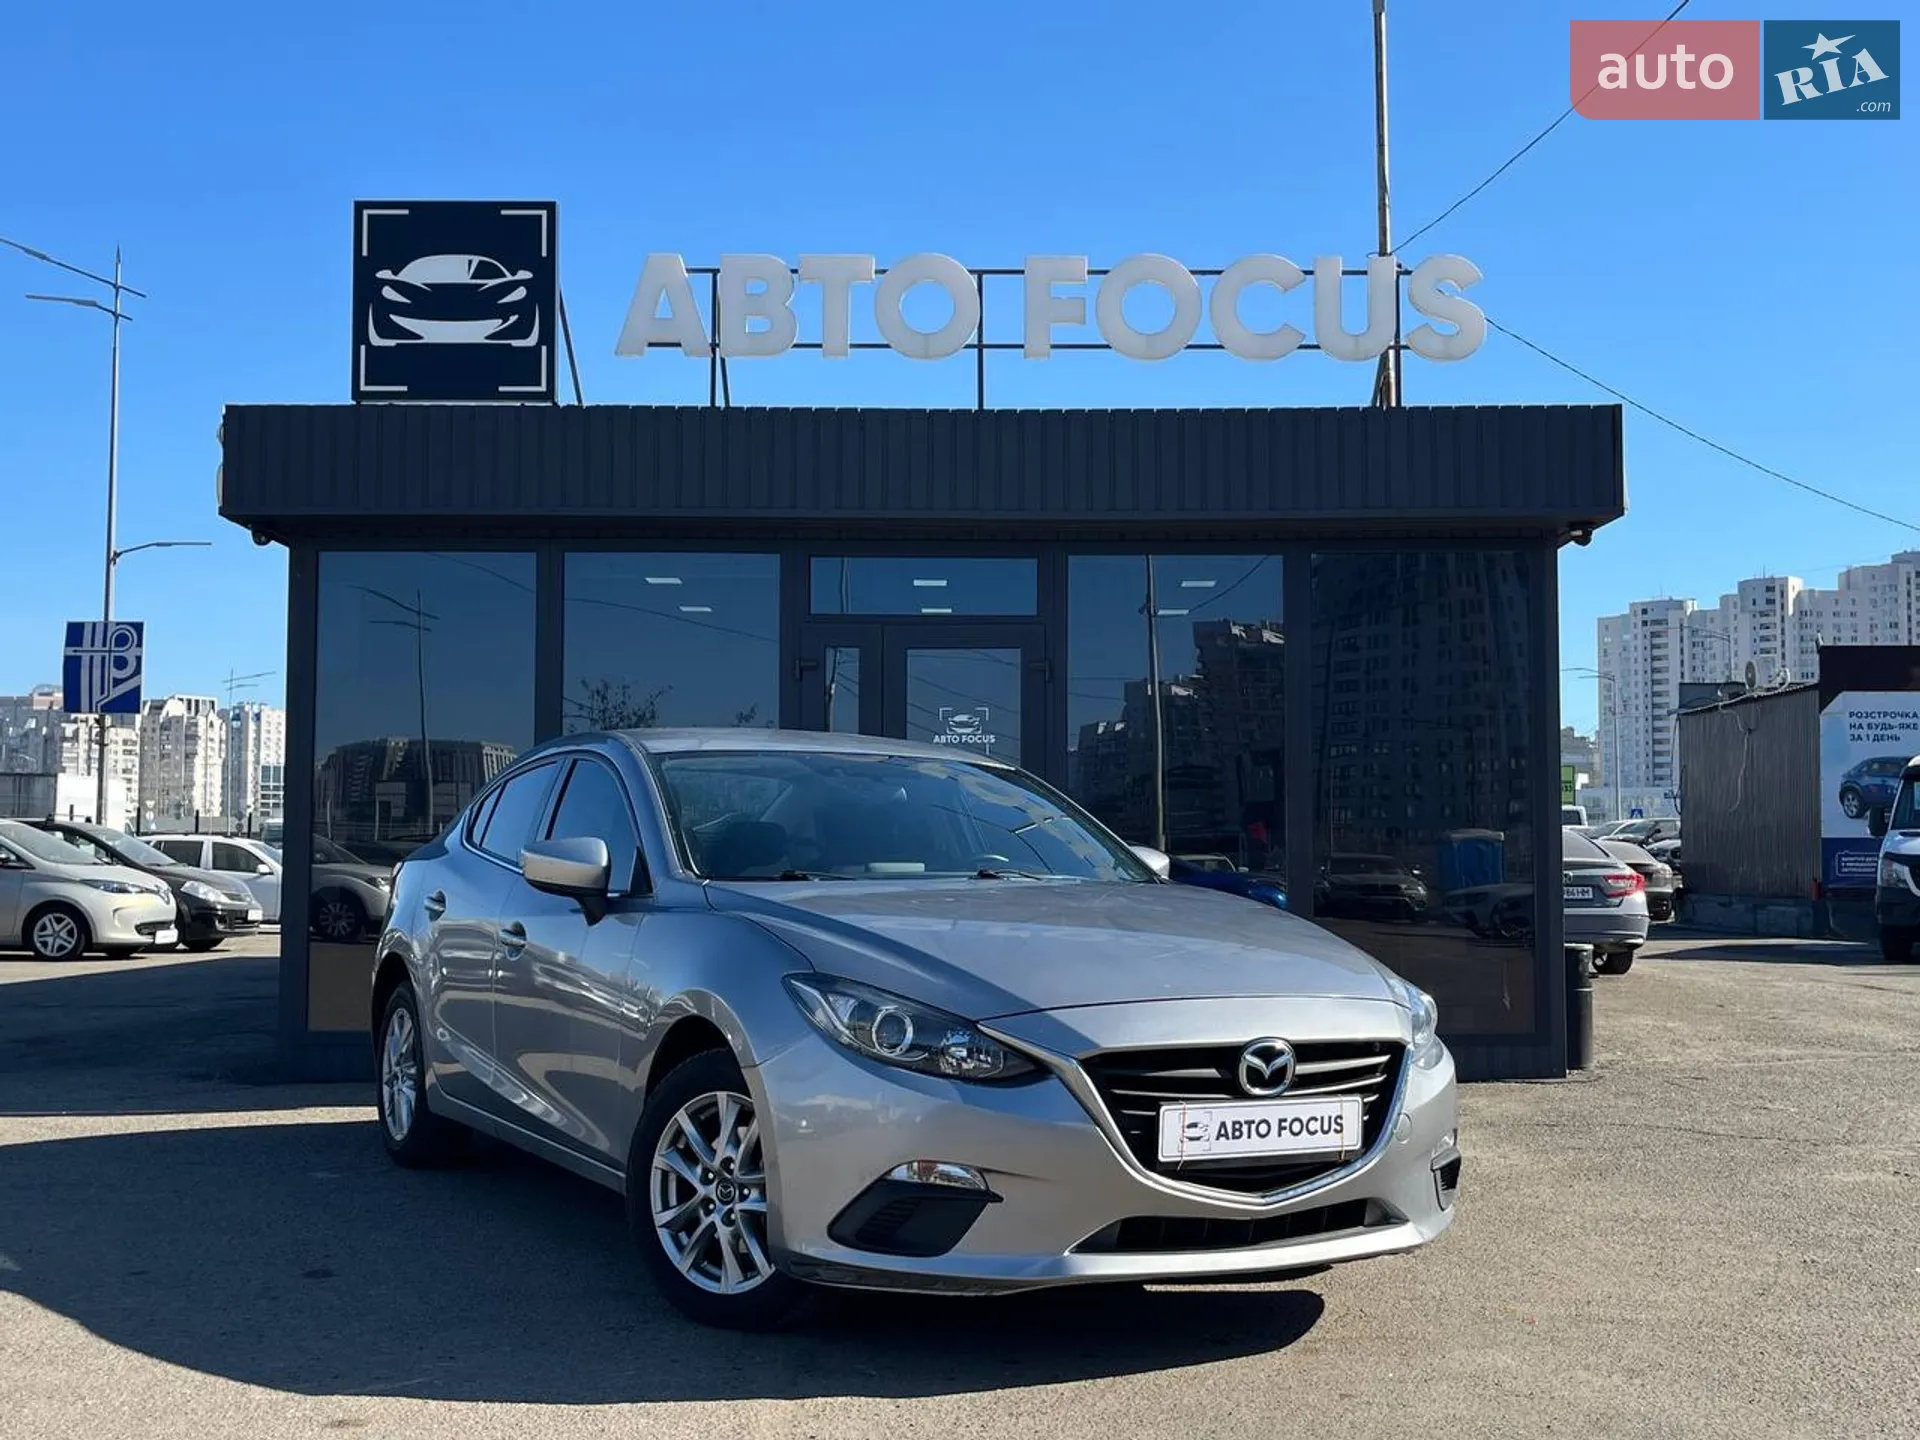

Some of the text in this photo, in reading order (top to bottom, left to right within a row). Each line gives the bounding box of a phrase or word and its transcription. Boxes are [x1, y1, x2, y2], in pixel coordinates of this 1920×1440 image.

[614, 251, 1488, 362] АВТО FOCUS
[1848, 711, 1919, 719] РОЗСТРОЧКА
[1849, 722, 1919, 731] НА БУДЬ-ЯКЕ
[933, 734, 996, 743] АВТО FOCUS
[1849, 734, 1863, 742] ЗА
[1872, 733, 1901, 742] ДЕНЬ
[1215, 1115, 1344, 1141] АВТО FOCUS
